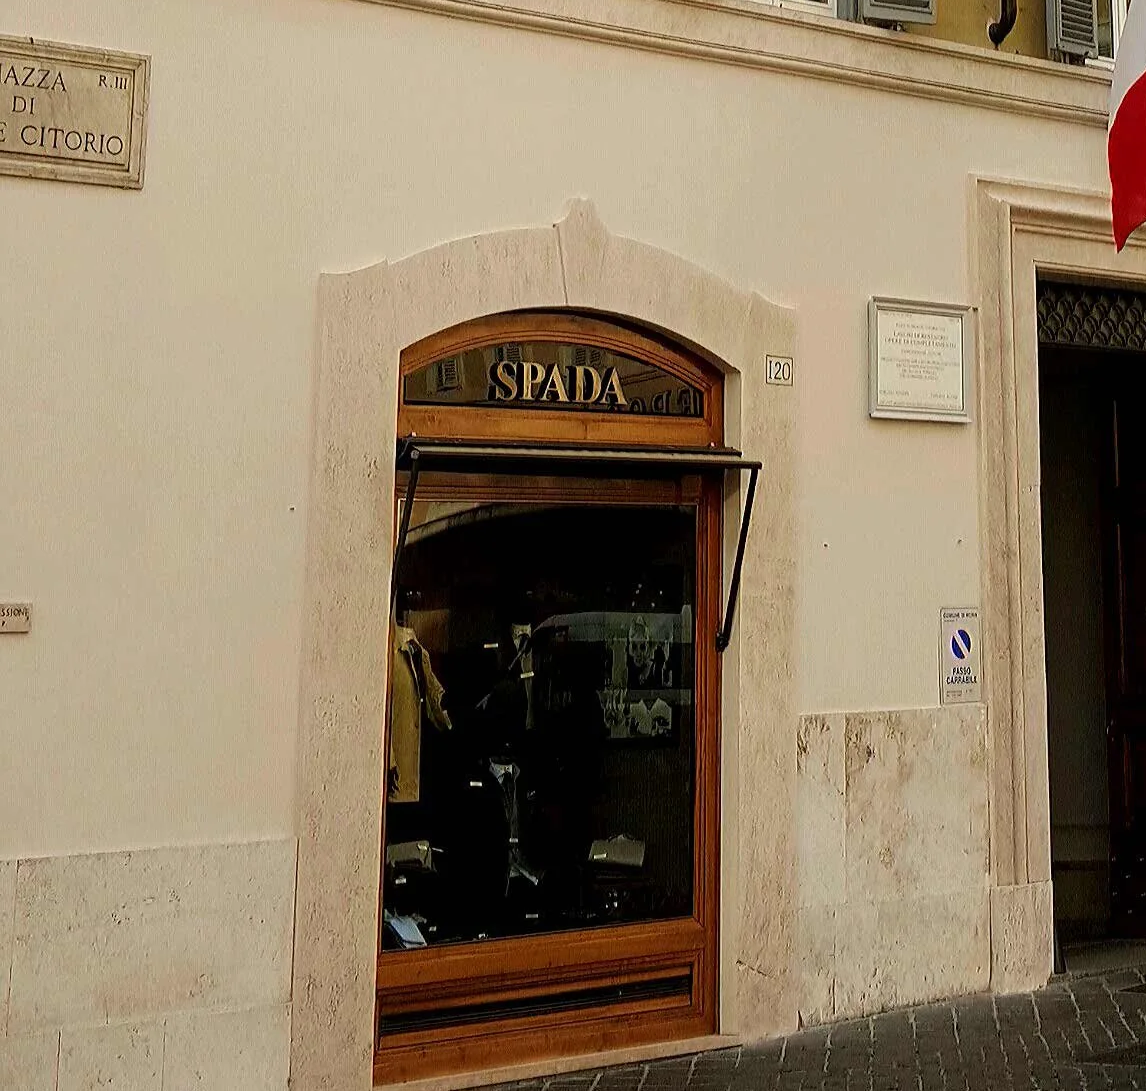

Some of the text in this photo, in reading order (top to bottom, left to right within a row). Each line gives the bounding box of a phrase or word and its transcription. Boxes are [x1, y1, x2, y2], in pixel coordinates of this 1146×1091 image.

[0, 62, 68, 92] IAZZA
[12, 95, 35, 115] DI
[20, 124, 125, 156] CITORIO
[491, 360, 629, 406] SPADA
[768, 360, 791, 381] 120
[952, 666, 971, 676] PASSO
